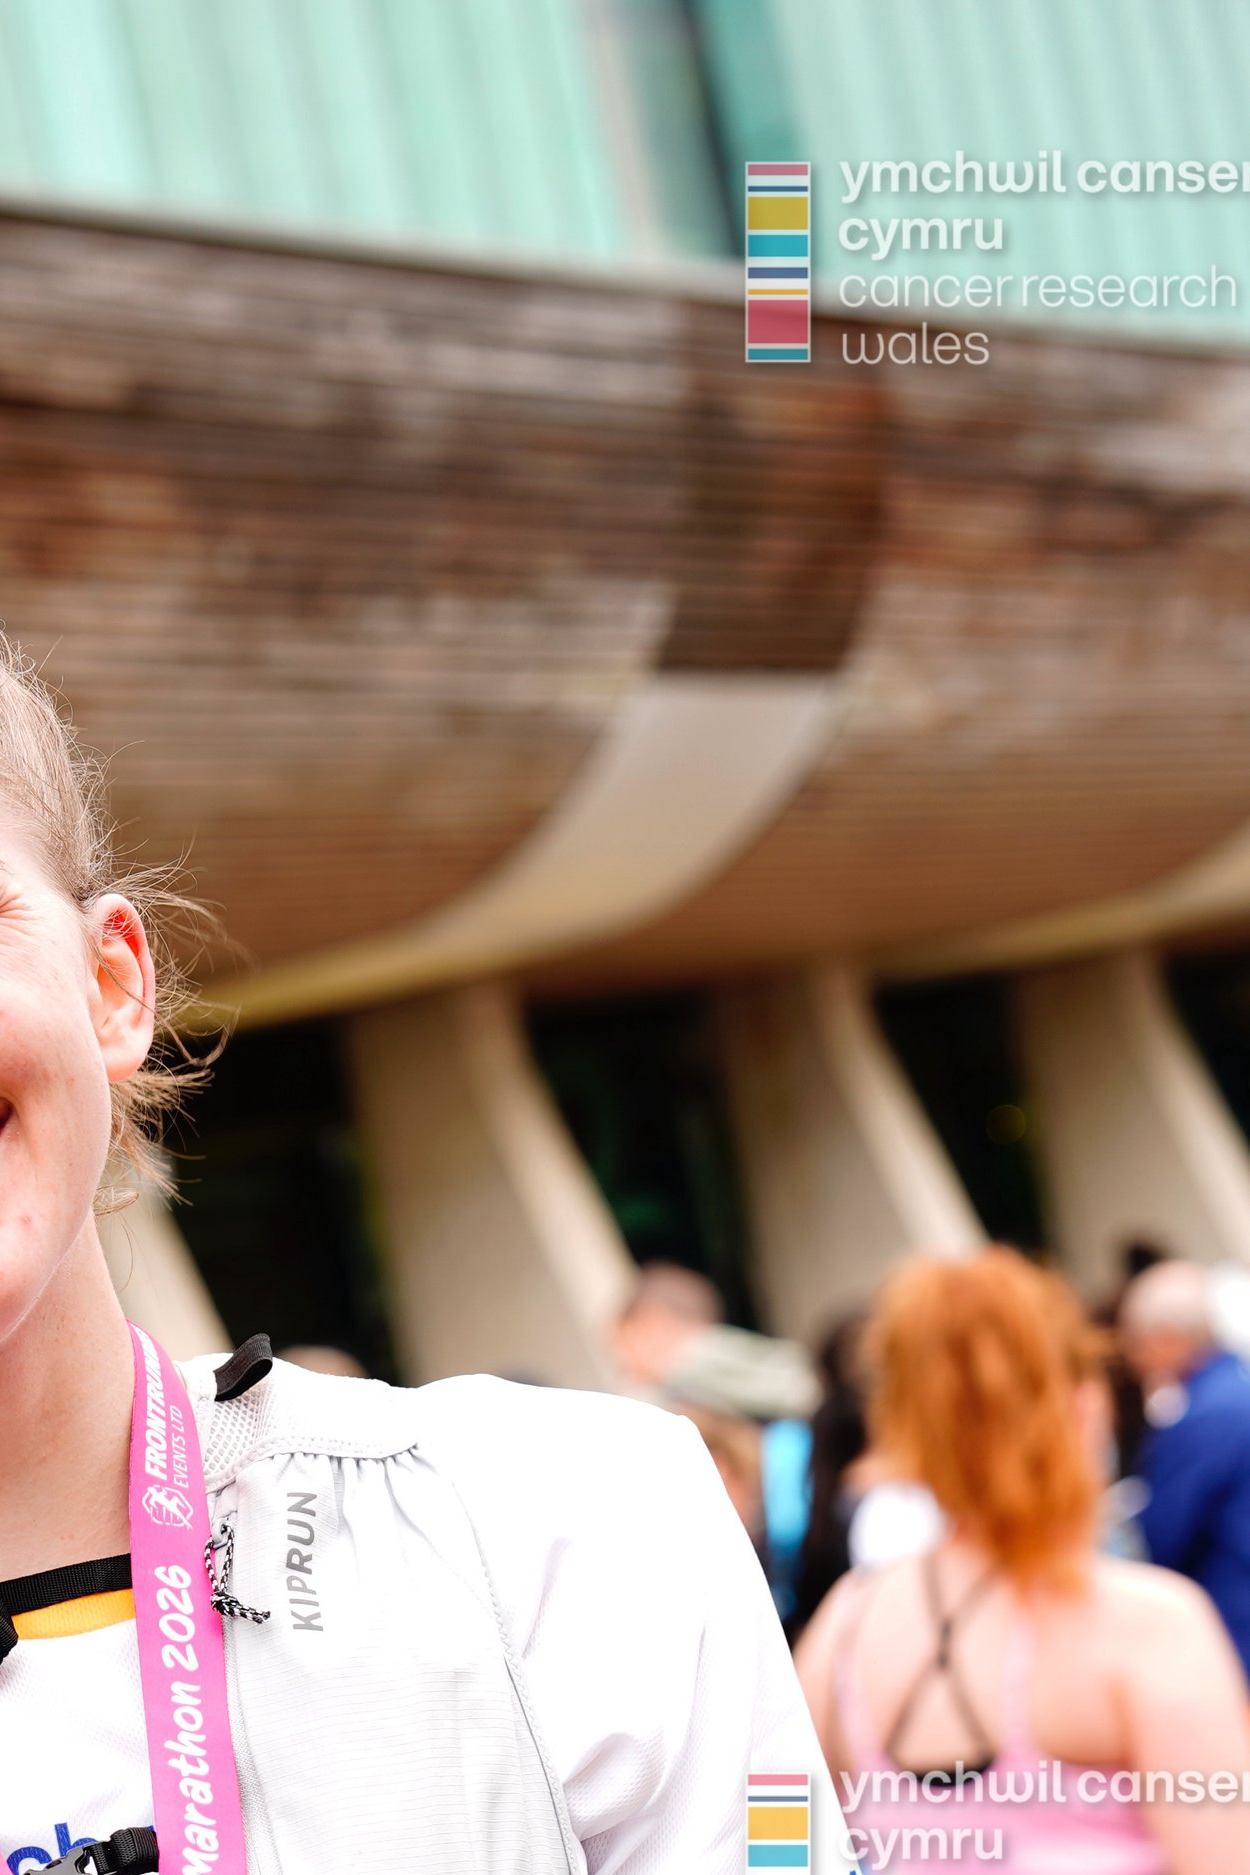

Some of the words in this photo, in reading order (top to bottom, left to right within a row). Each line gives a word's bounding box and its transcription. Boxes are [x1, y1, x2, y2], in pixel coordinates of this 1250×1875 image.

[170, 1405, 184, 1433] LTD
[170, 1433, 189, 1488] EVENTS
[286, 1492, 324, 1632] KIPRUN
[154, 1564, 200, 1672] 2026
